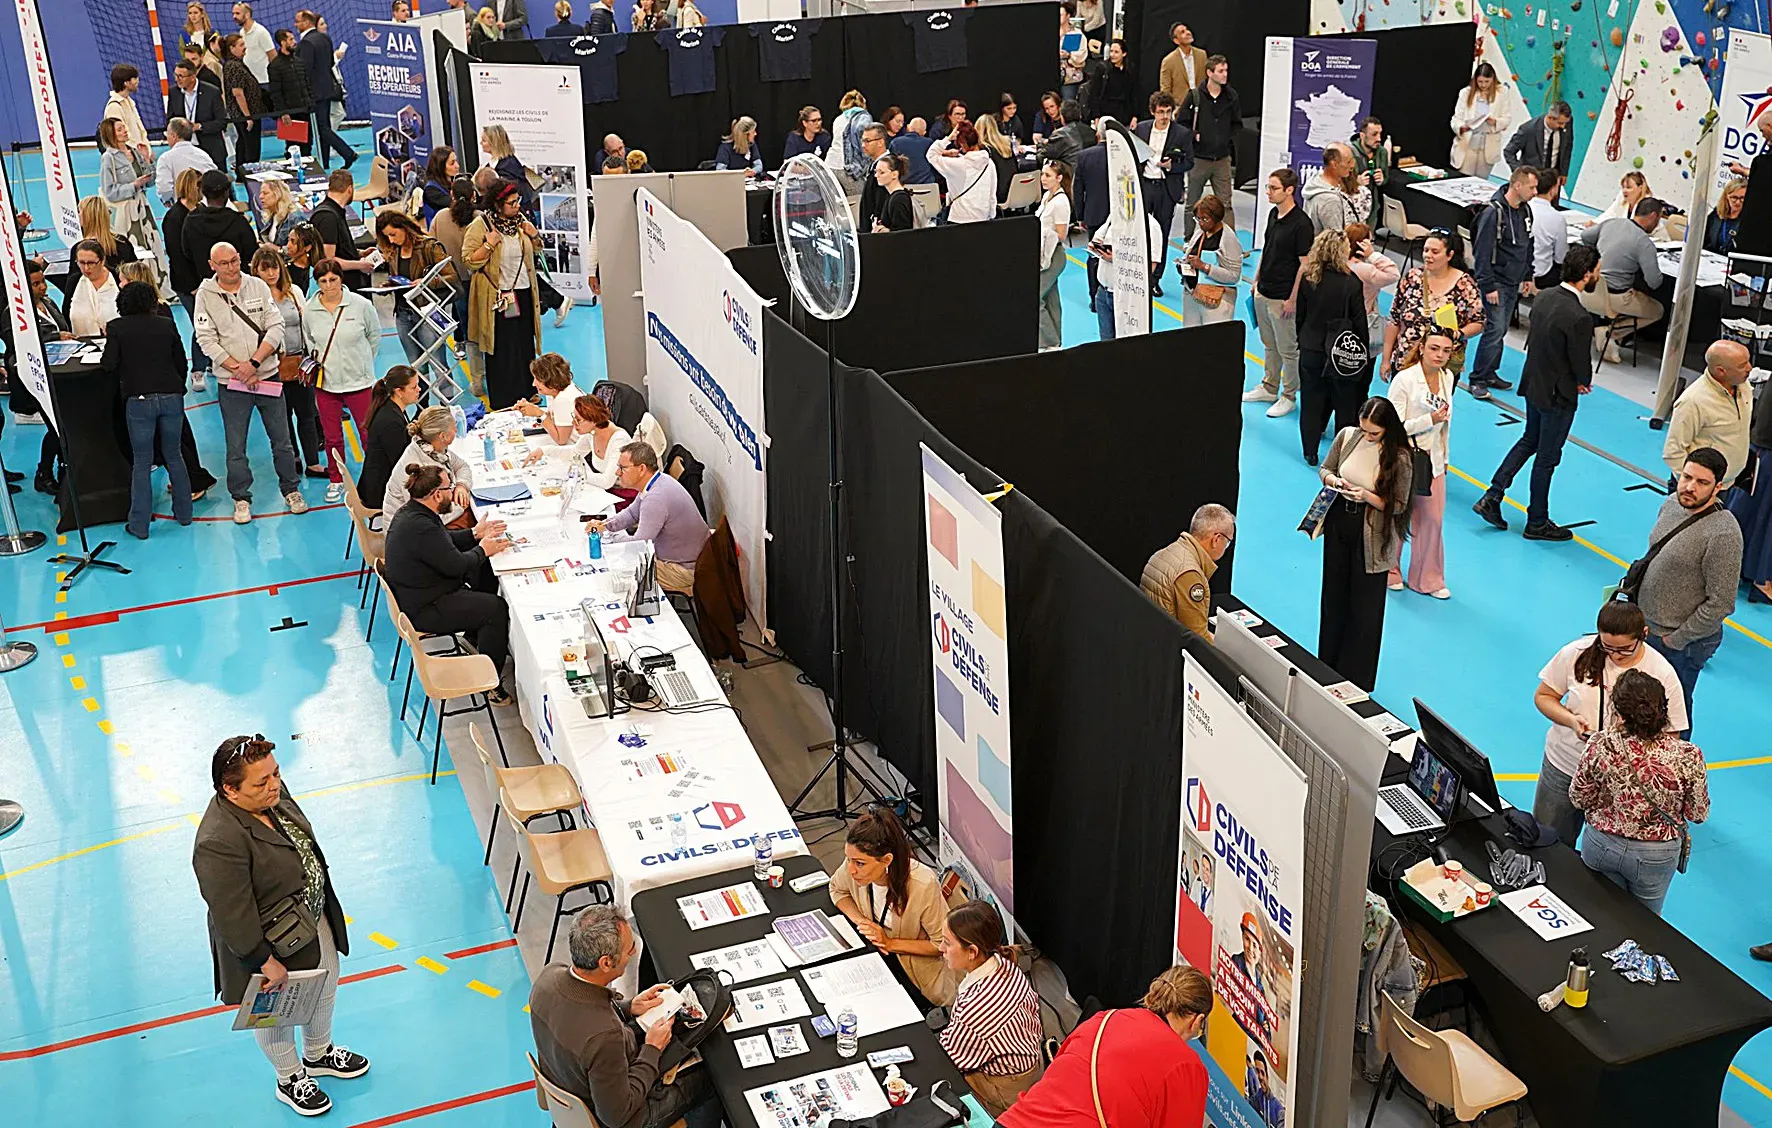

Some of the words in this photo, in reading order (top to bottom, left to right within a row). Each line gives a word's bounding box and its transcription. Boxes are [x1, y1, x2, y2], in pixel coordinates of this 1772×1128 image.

[771, 23, 785, 34] Civils
[926, 11, 940, 23] Civils
[930, 22, 950, 30] Marine
[386, 32, 417, 53] AIA
[570, 35, 585, 47] Civils
[676, 27, 690, 38] Civils
[680, 39, 700, 47] Marine
[775, 34, 794, 42] Marine
[574, 47, 596, 55] Marine
[367, 64, 410, 84] RECRUTE
[1301, 62, 1321, 70] DGA
[369, 81, 381, 90] DES
[732, 297, 749, 328] CIVILS
[932, 580, 941, 600] LE
[941, 590, 974, 634] VILLAGE
[952, 627, 985, 675] CIVILS
[952, 648, 999, 716] DÉFENSE
[1187, 694, 1210, 723] MINISTÈRE
[1187, 703, 1196, 717] DES
[1196, 713, 1213, 736] ARMÉES
[1216, 802, 1269, 877] CIVILS
[1268, 858, 1280, 879] DE
[640, 843, 718, 866] CIVILS
[1214, 829, 1292, 936] DÉFENSE
[1527, 898, 1568, 929] SGA
[1218, 966, 1225, 980] A
[1225, 975, 1255, 1015] BESOIN
[1219, 948, 1245, 984] NOTRE
[1245, 979, 1277, 1028] MISSION
[280, 994, 291, 1017] Contrat
[289, 986, 294, 995] de
[1217, 982, 1229, 1001] DE
[1229, 996, 1245, 1022] VOS
[1246, 1016, 1278, 1066] TALENTS
